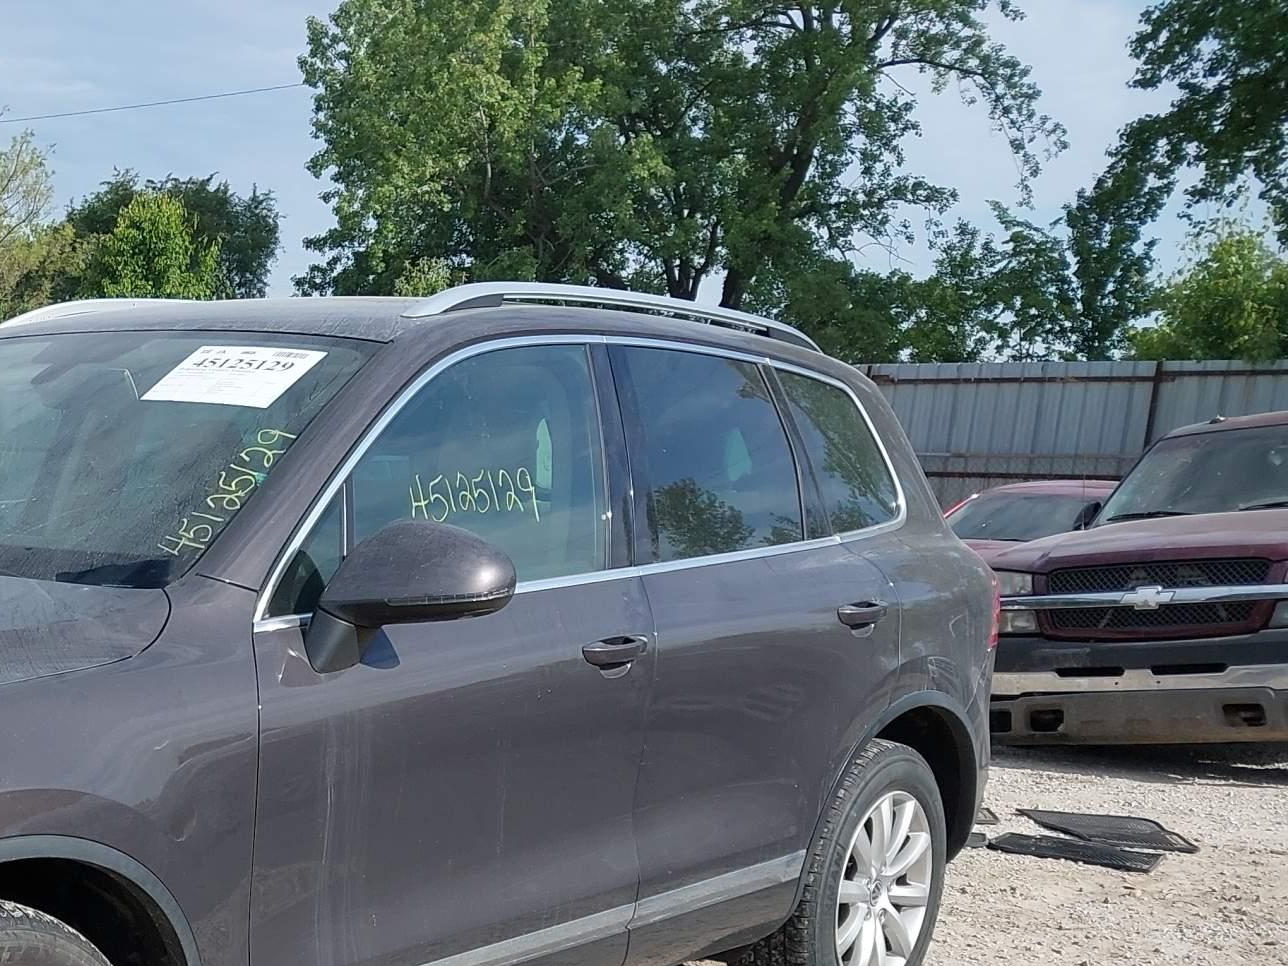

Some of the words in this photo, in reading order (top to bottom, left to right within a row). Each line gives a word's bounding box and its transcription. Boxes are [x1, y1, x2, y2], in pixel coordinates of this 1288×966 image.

[192, 357, 295, 372] 45125129
[157, 428, 298, 556] 45125129
[409, 467, 540, 523] 45125129
